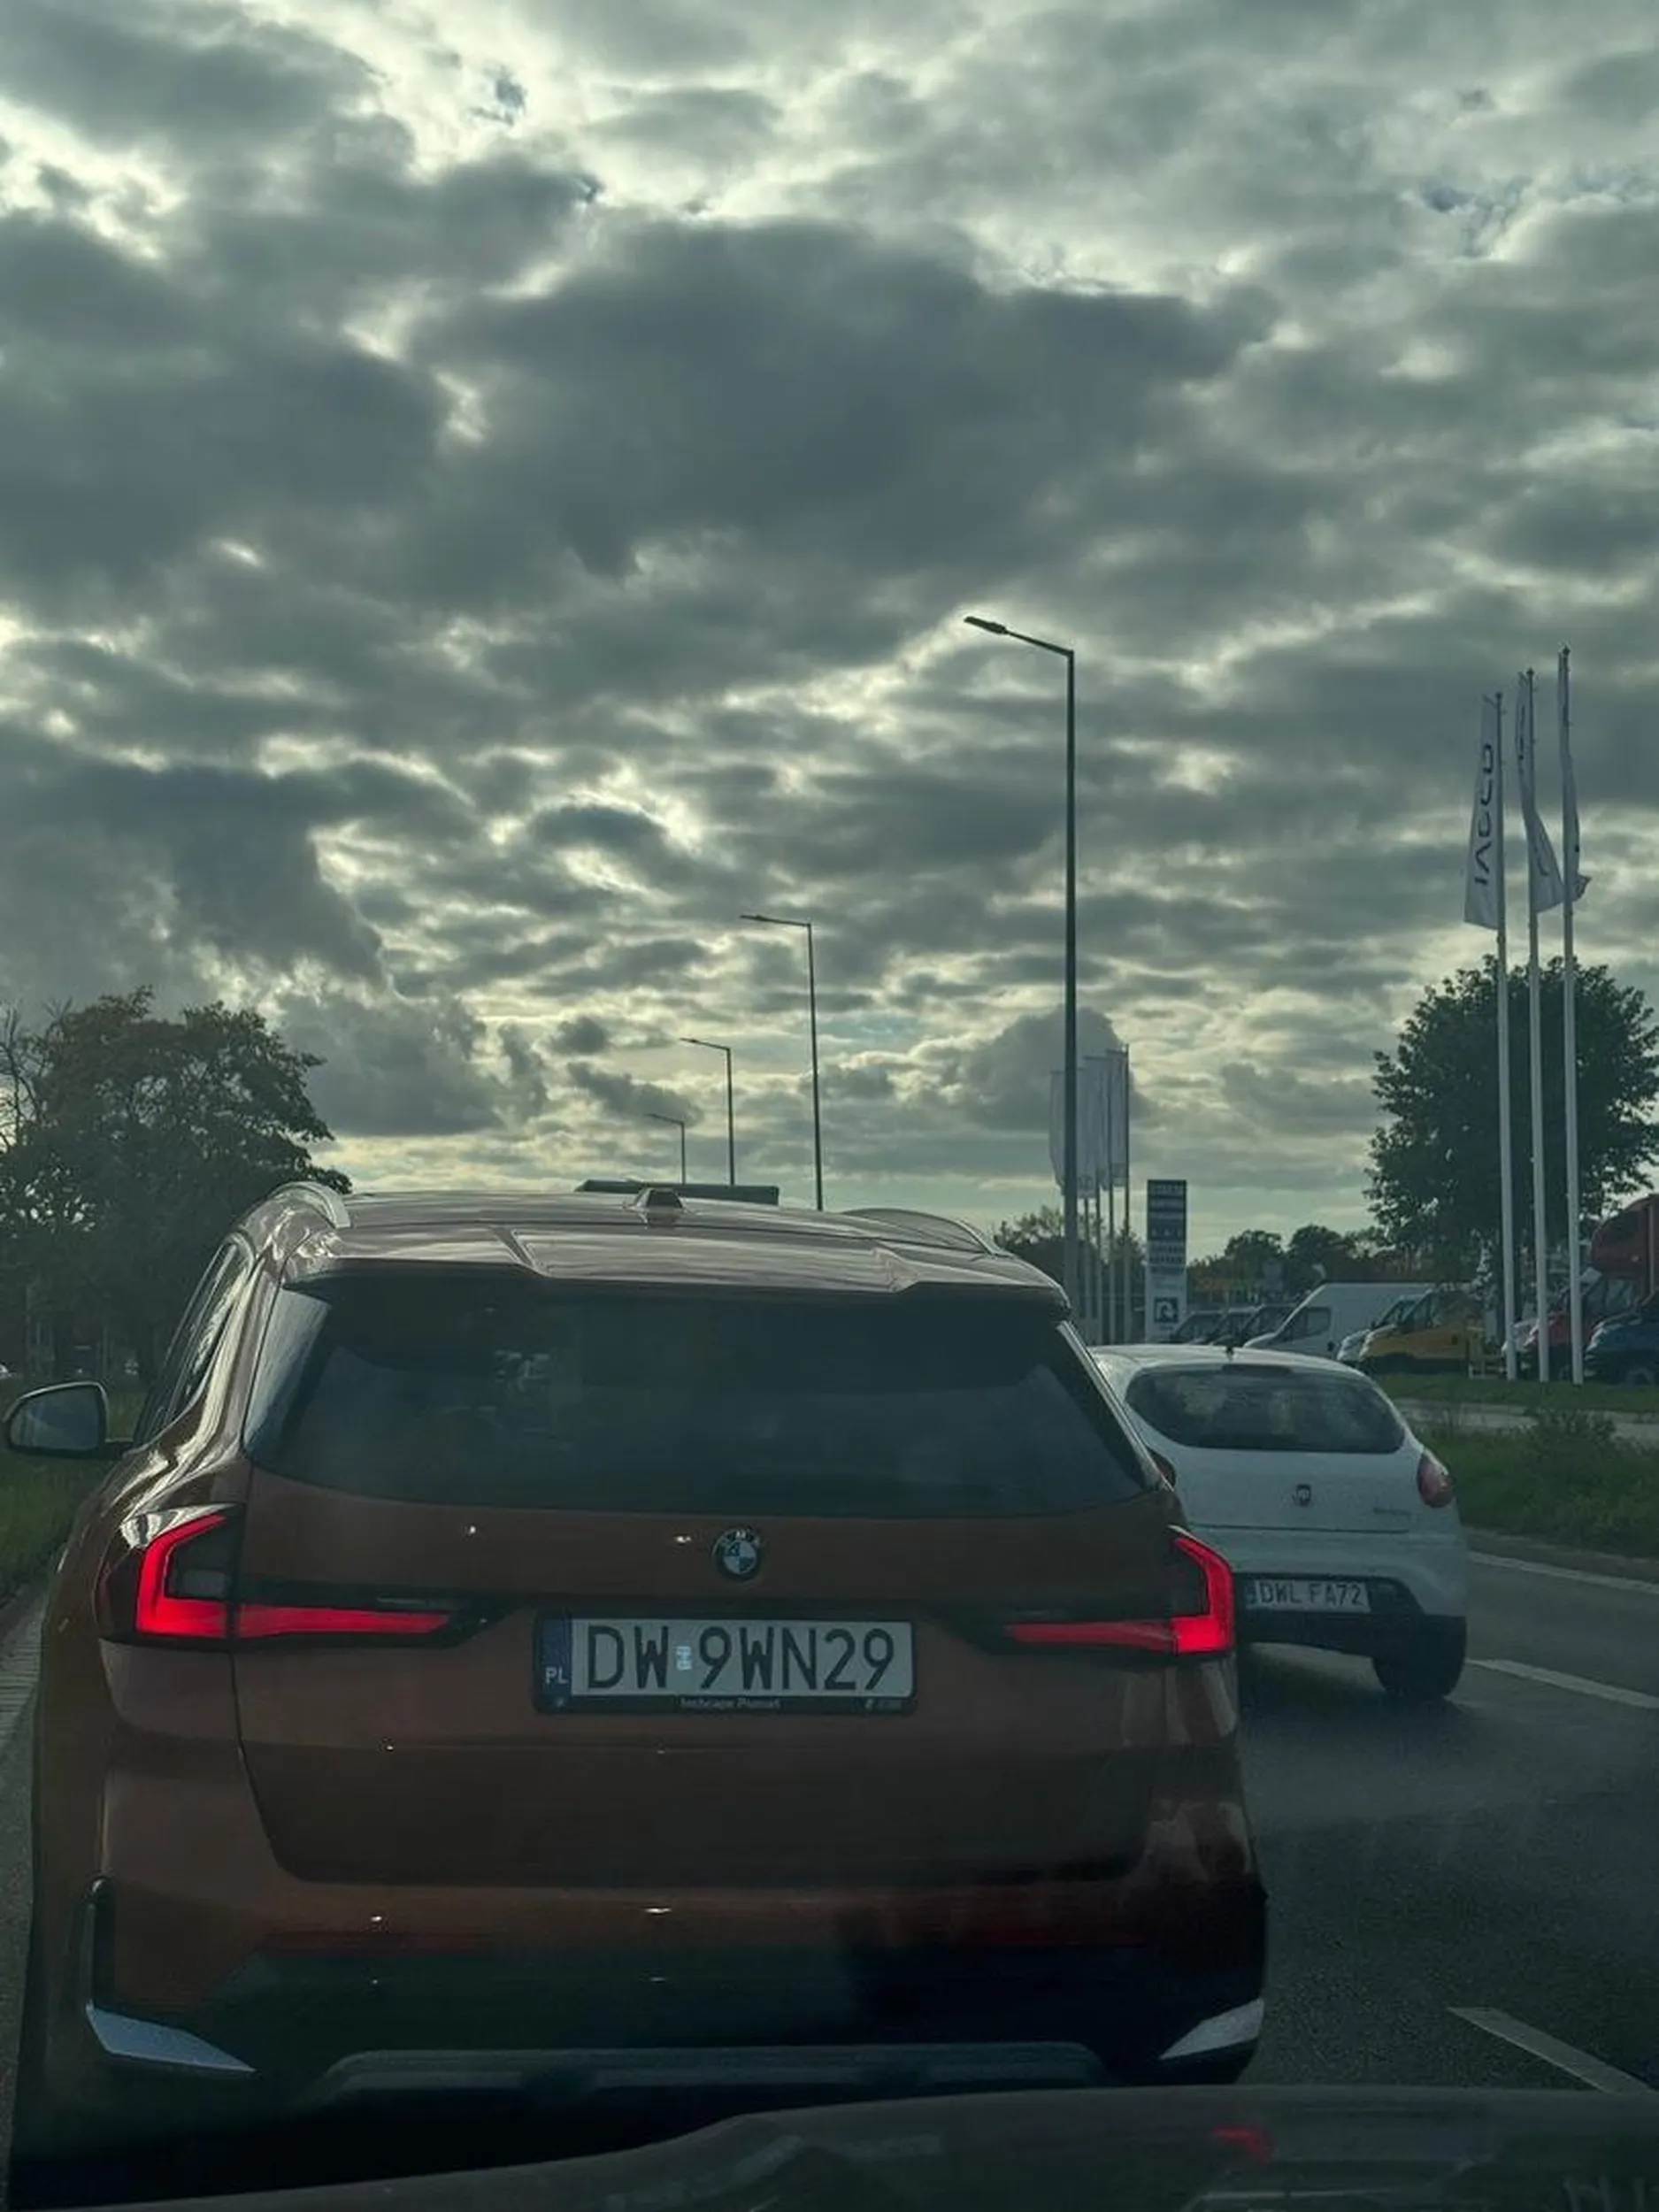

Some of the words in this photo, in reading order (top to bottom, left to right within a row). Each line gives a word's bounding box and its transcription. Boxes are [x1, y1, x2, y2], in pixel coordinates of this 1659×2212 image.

[1310, 1583, 1362, 1607] FA72
[587, 1624, 670, 1689] DW
[699, 1625, 895, 1692] 9WN29
[545, 1666, 569, 1685] PL
